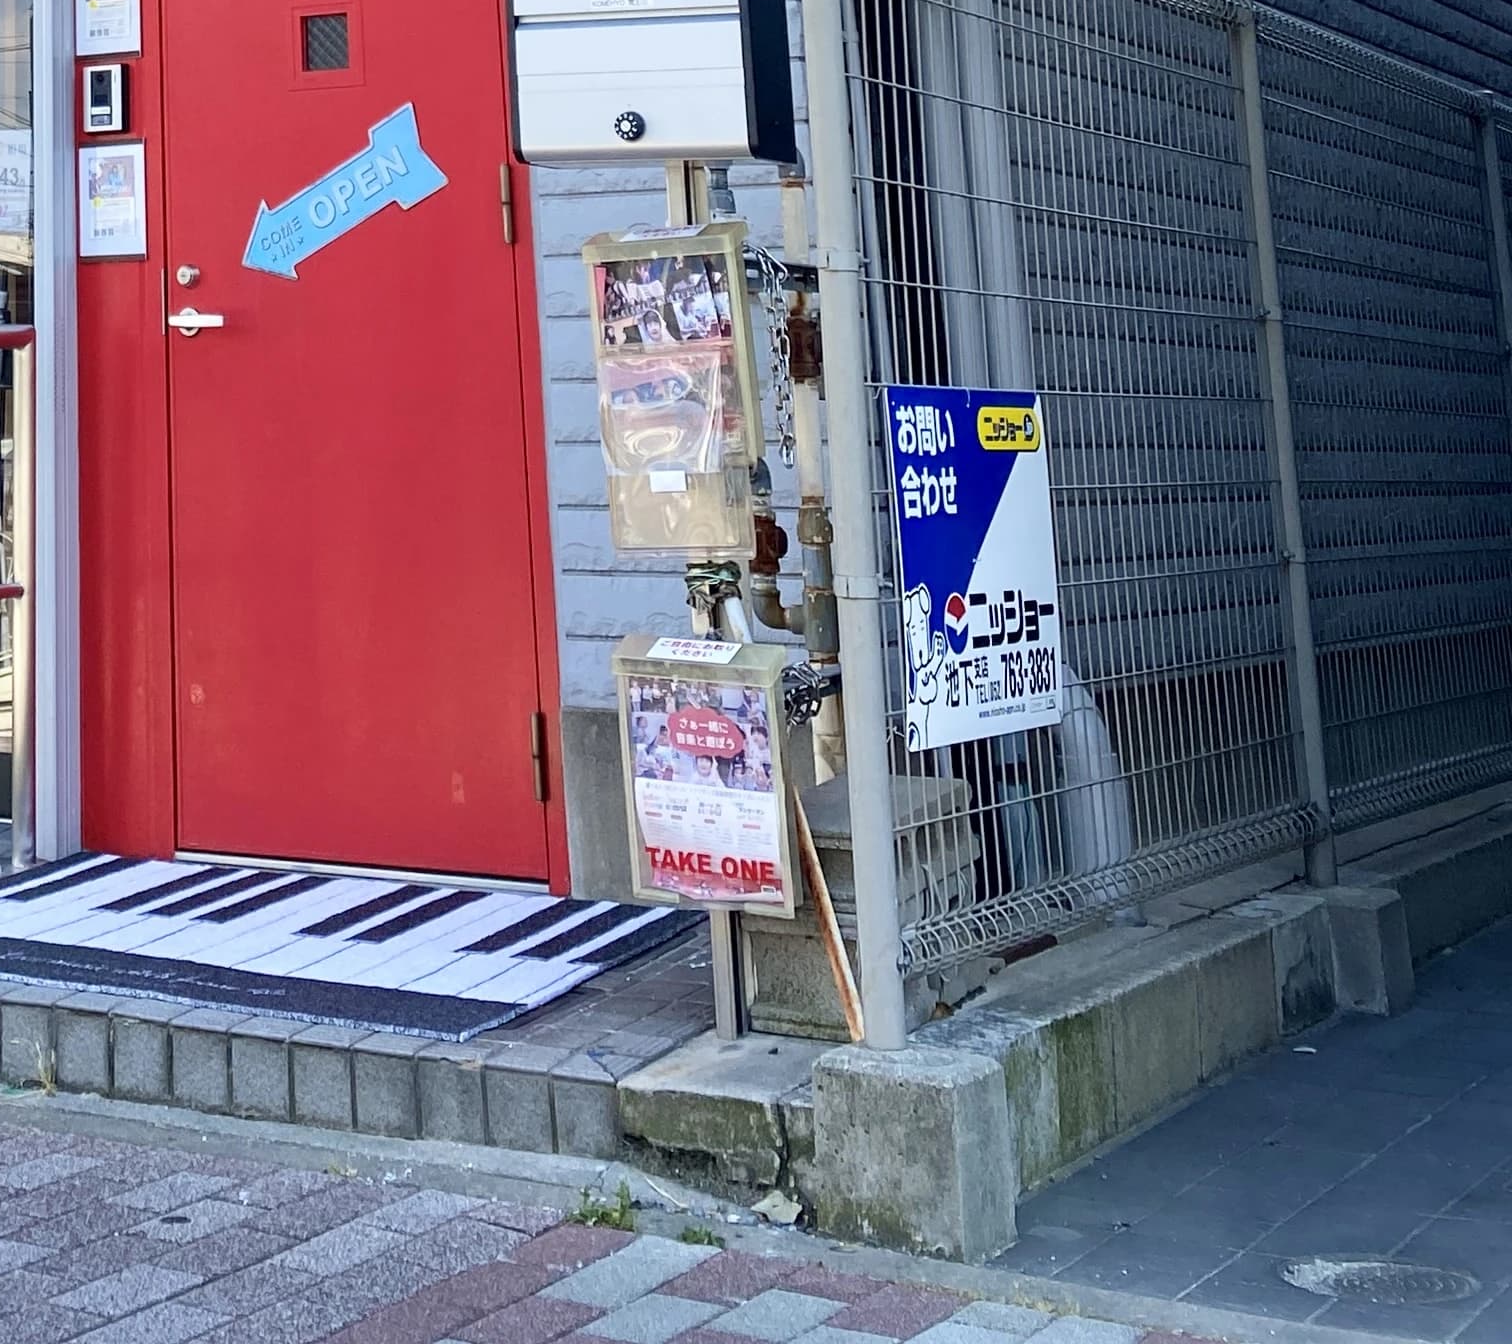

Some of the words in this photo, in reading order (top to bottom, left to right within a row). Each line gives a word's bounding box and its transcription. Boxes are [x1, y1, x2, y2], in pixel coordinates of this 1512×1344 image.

[307, 144, 409, 232] OPEN
[260, 215, 303, 252] COME
[278, 238, 296, 261] IN
[895, 404, 955, 457] お問い
[901, 464, 958, 519] 合わせ
[968, 588, 1055, 650] ニッショー
[1000, 646, 1057, 700] 763-3831
[645, 845, 713, 876] TAKE
[720, 856, 776, 884] ONE
